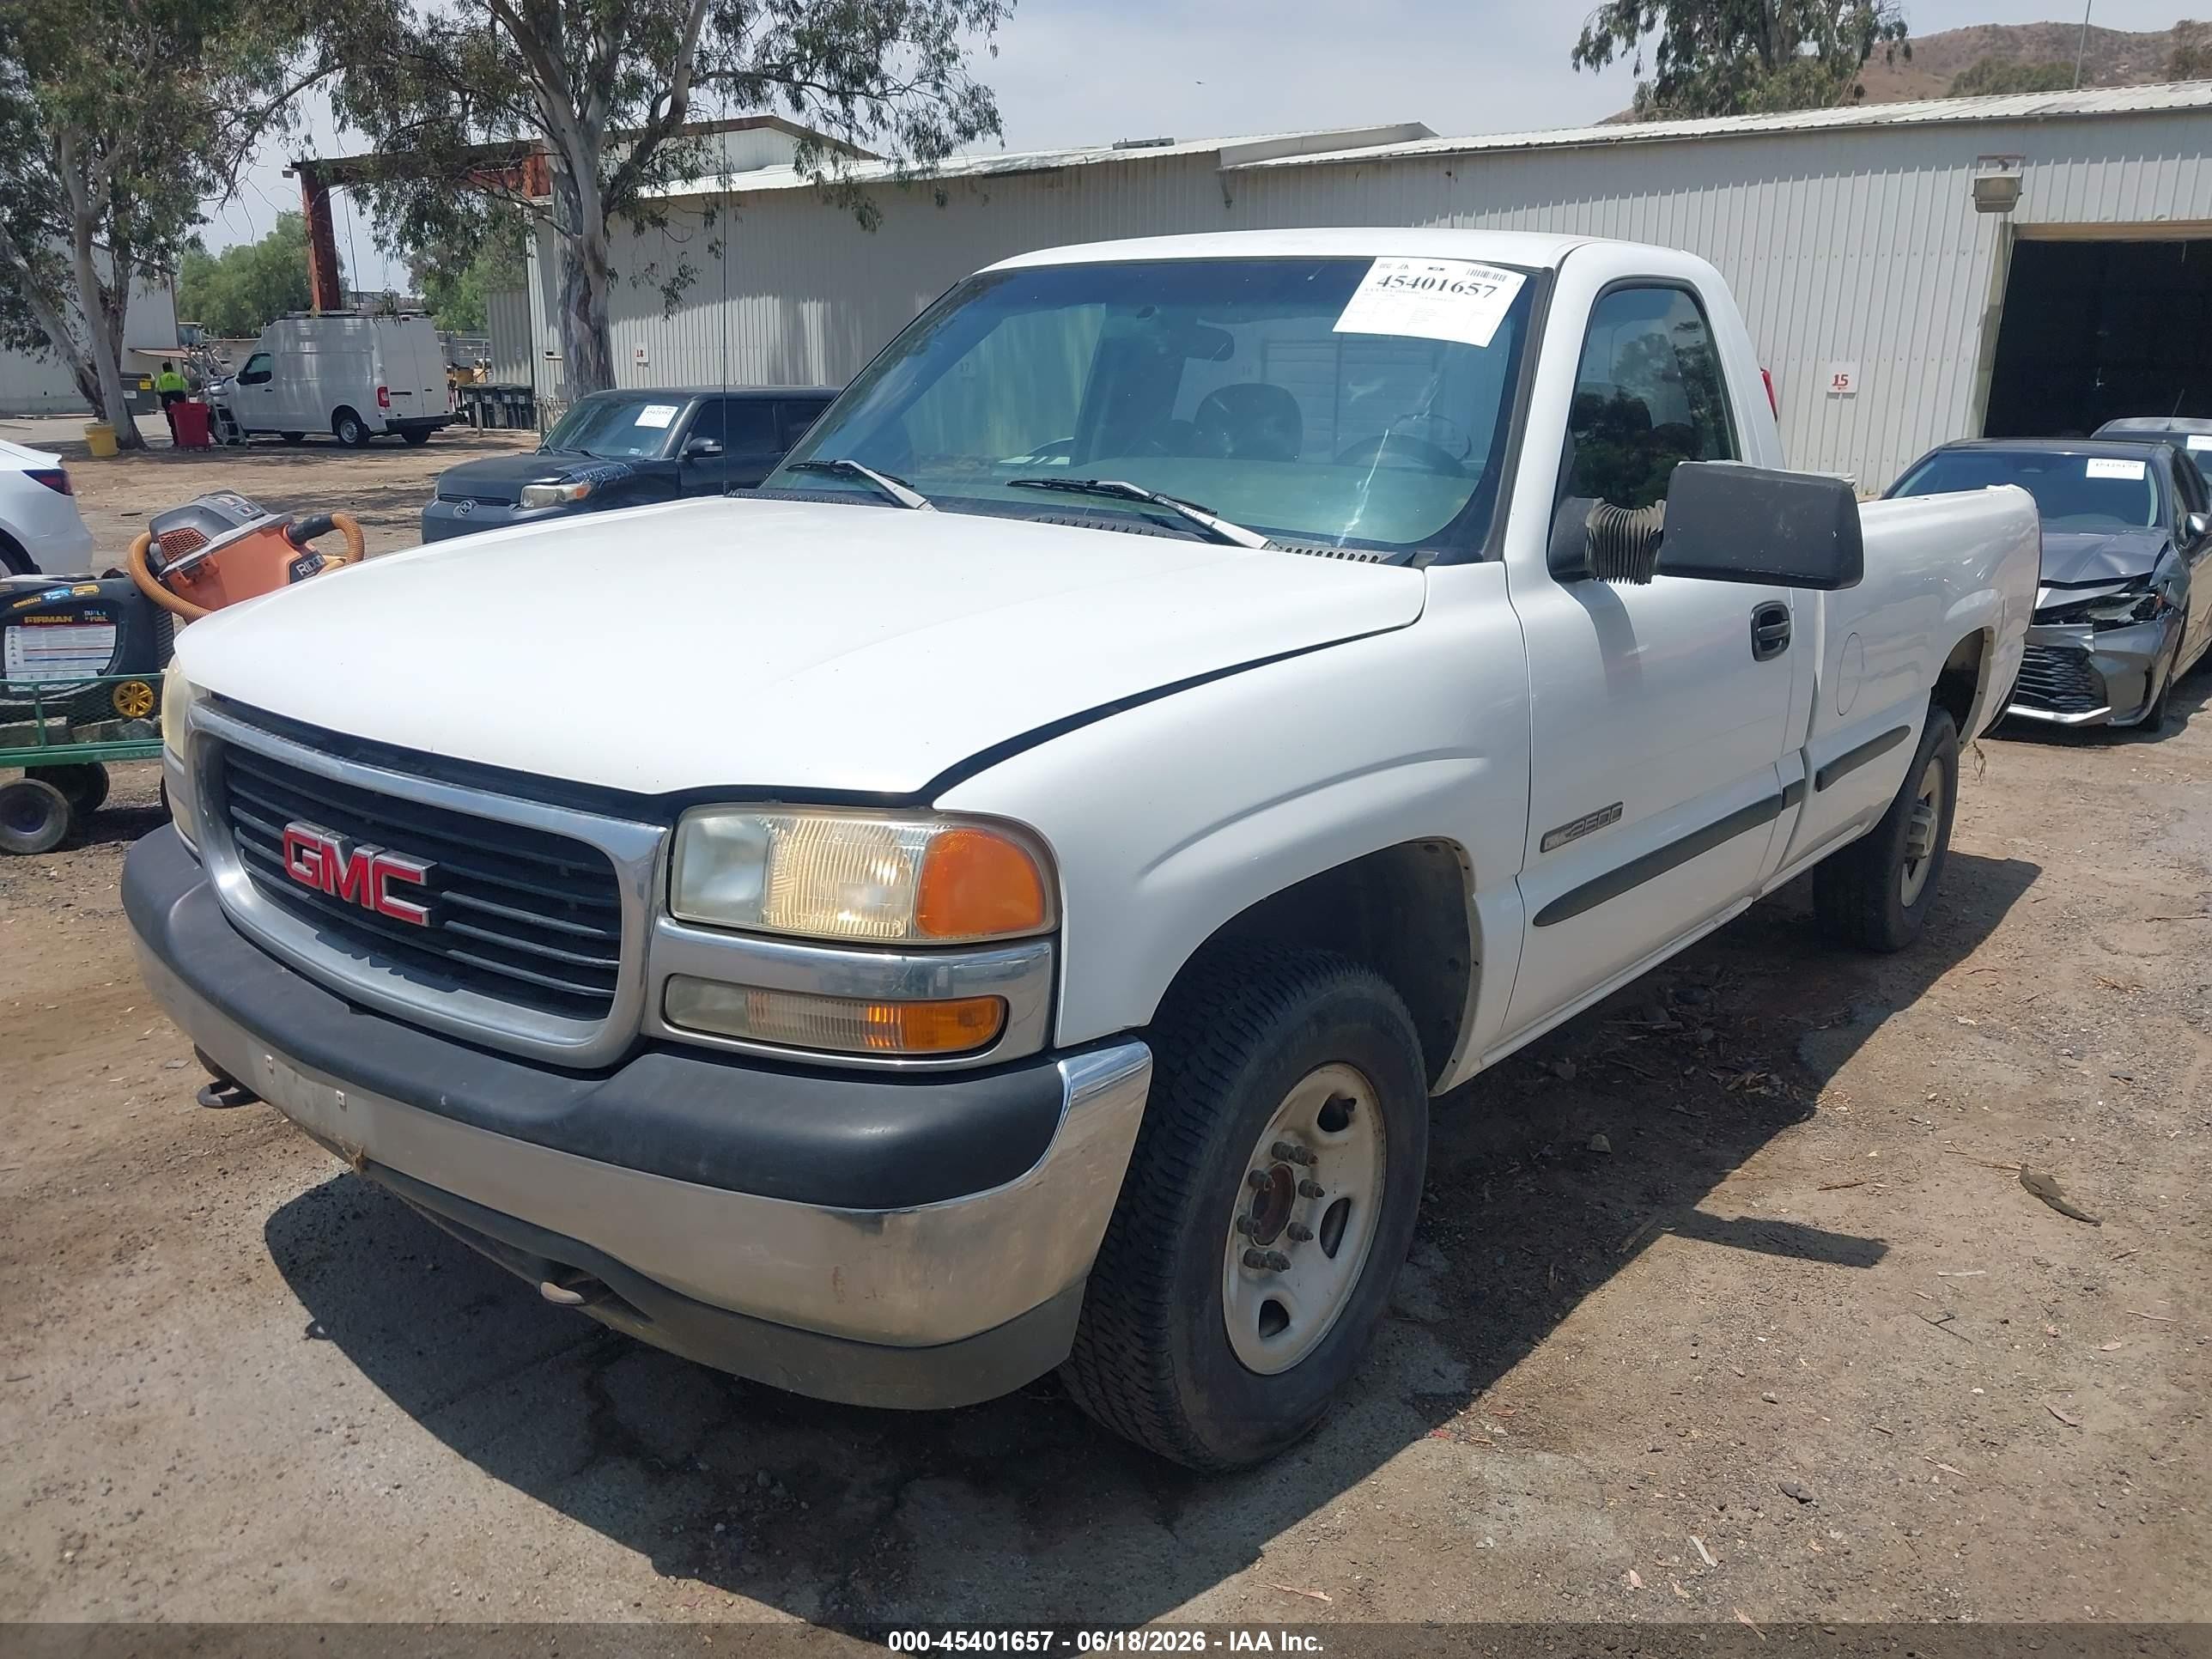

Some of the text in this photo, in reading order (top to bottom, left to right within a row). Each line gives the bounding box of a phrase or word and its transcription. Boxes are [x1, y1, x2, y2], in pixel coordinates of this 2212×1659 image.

[1376, 274, 1498, 299] 45401657
[1832, 374, 1849, 386] 15
[284, 821, 435, 927] GMC
